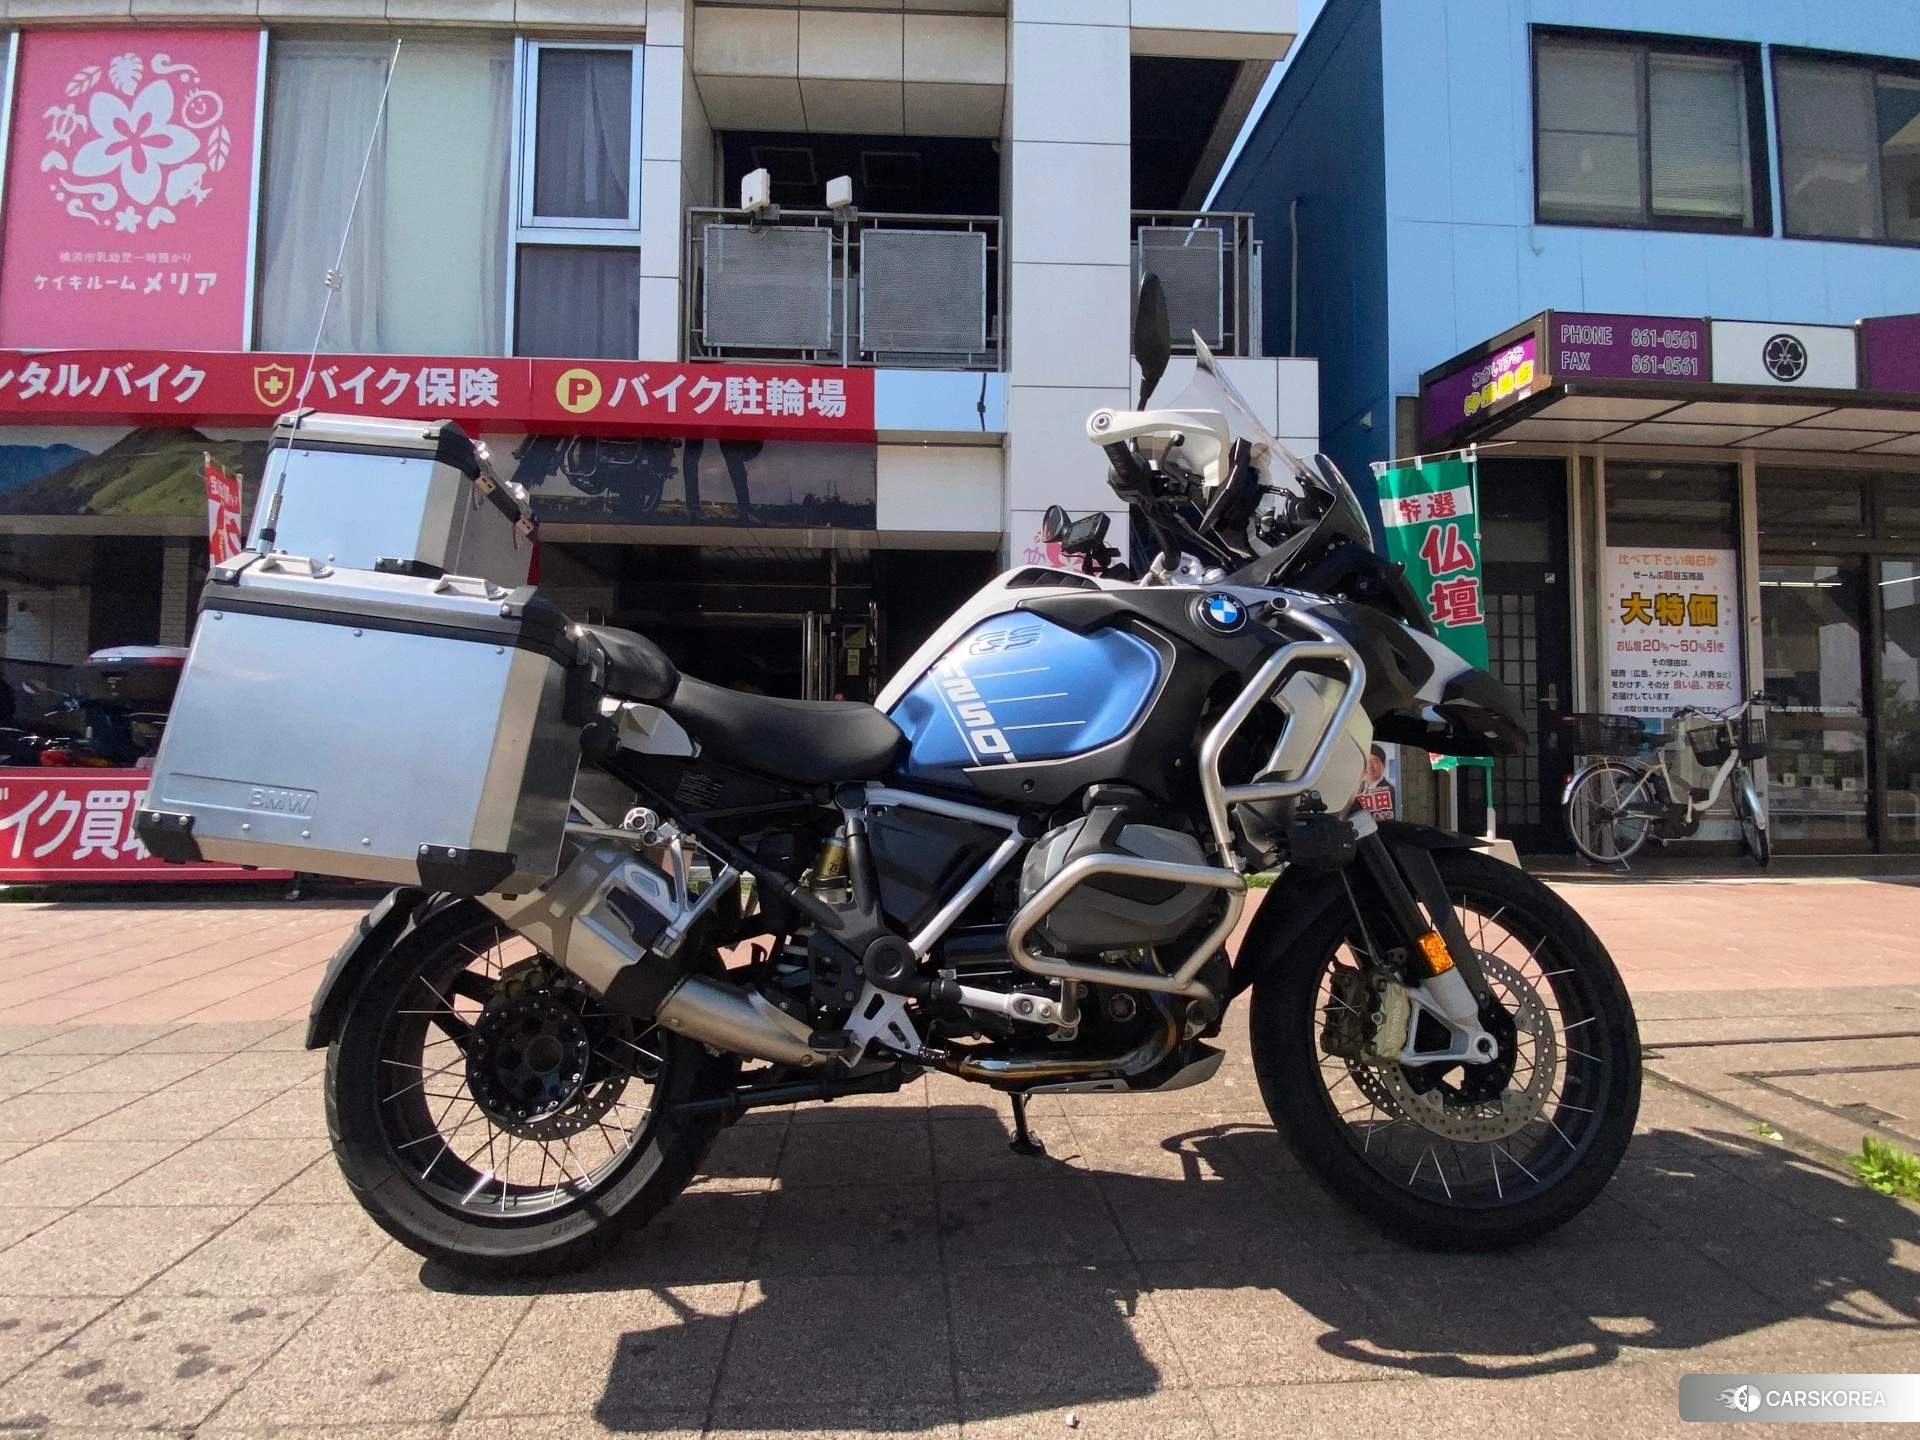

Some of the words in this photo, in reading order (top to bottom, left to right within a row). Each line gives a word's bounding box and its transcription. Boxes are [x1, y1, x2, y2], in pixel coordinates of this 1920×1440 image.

[34, 275, 136, 290] ケイキルーム
[143, 272, 217, 294] メリア
[1561, 325, 1613, 346] PHONE
[1631, 328, 1698, 349] 861-0561
[1561, 351, 1591, 371] FAX
[1631, 355, 1698, 375] 861-0561
[295, 366, 499, 408] バイク保険
[568, 377, 593, 406] P
[607, 373, 847, 418] バイク駐輪場
[1399, 491, 1456, 524] 特選
[1618, 553, 1718, 567] 比べて下さい毎日が
[1420, 524, 1484, 628] 仏壇
[1206, 594, 1241, 608] BMW
[1620, 592, 1719, 627] 大特価
[969, 624, 1045, 655] GS
[248, 788, 312, 813] BMW
